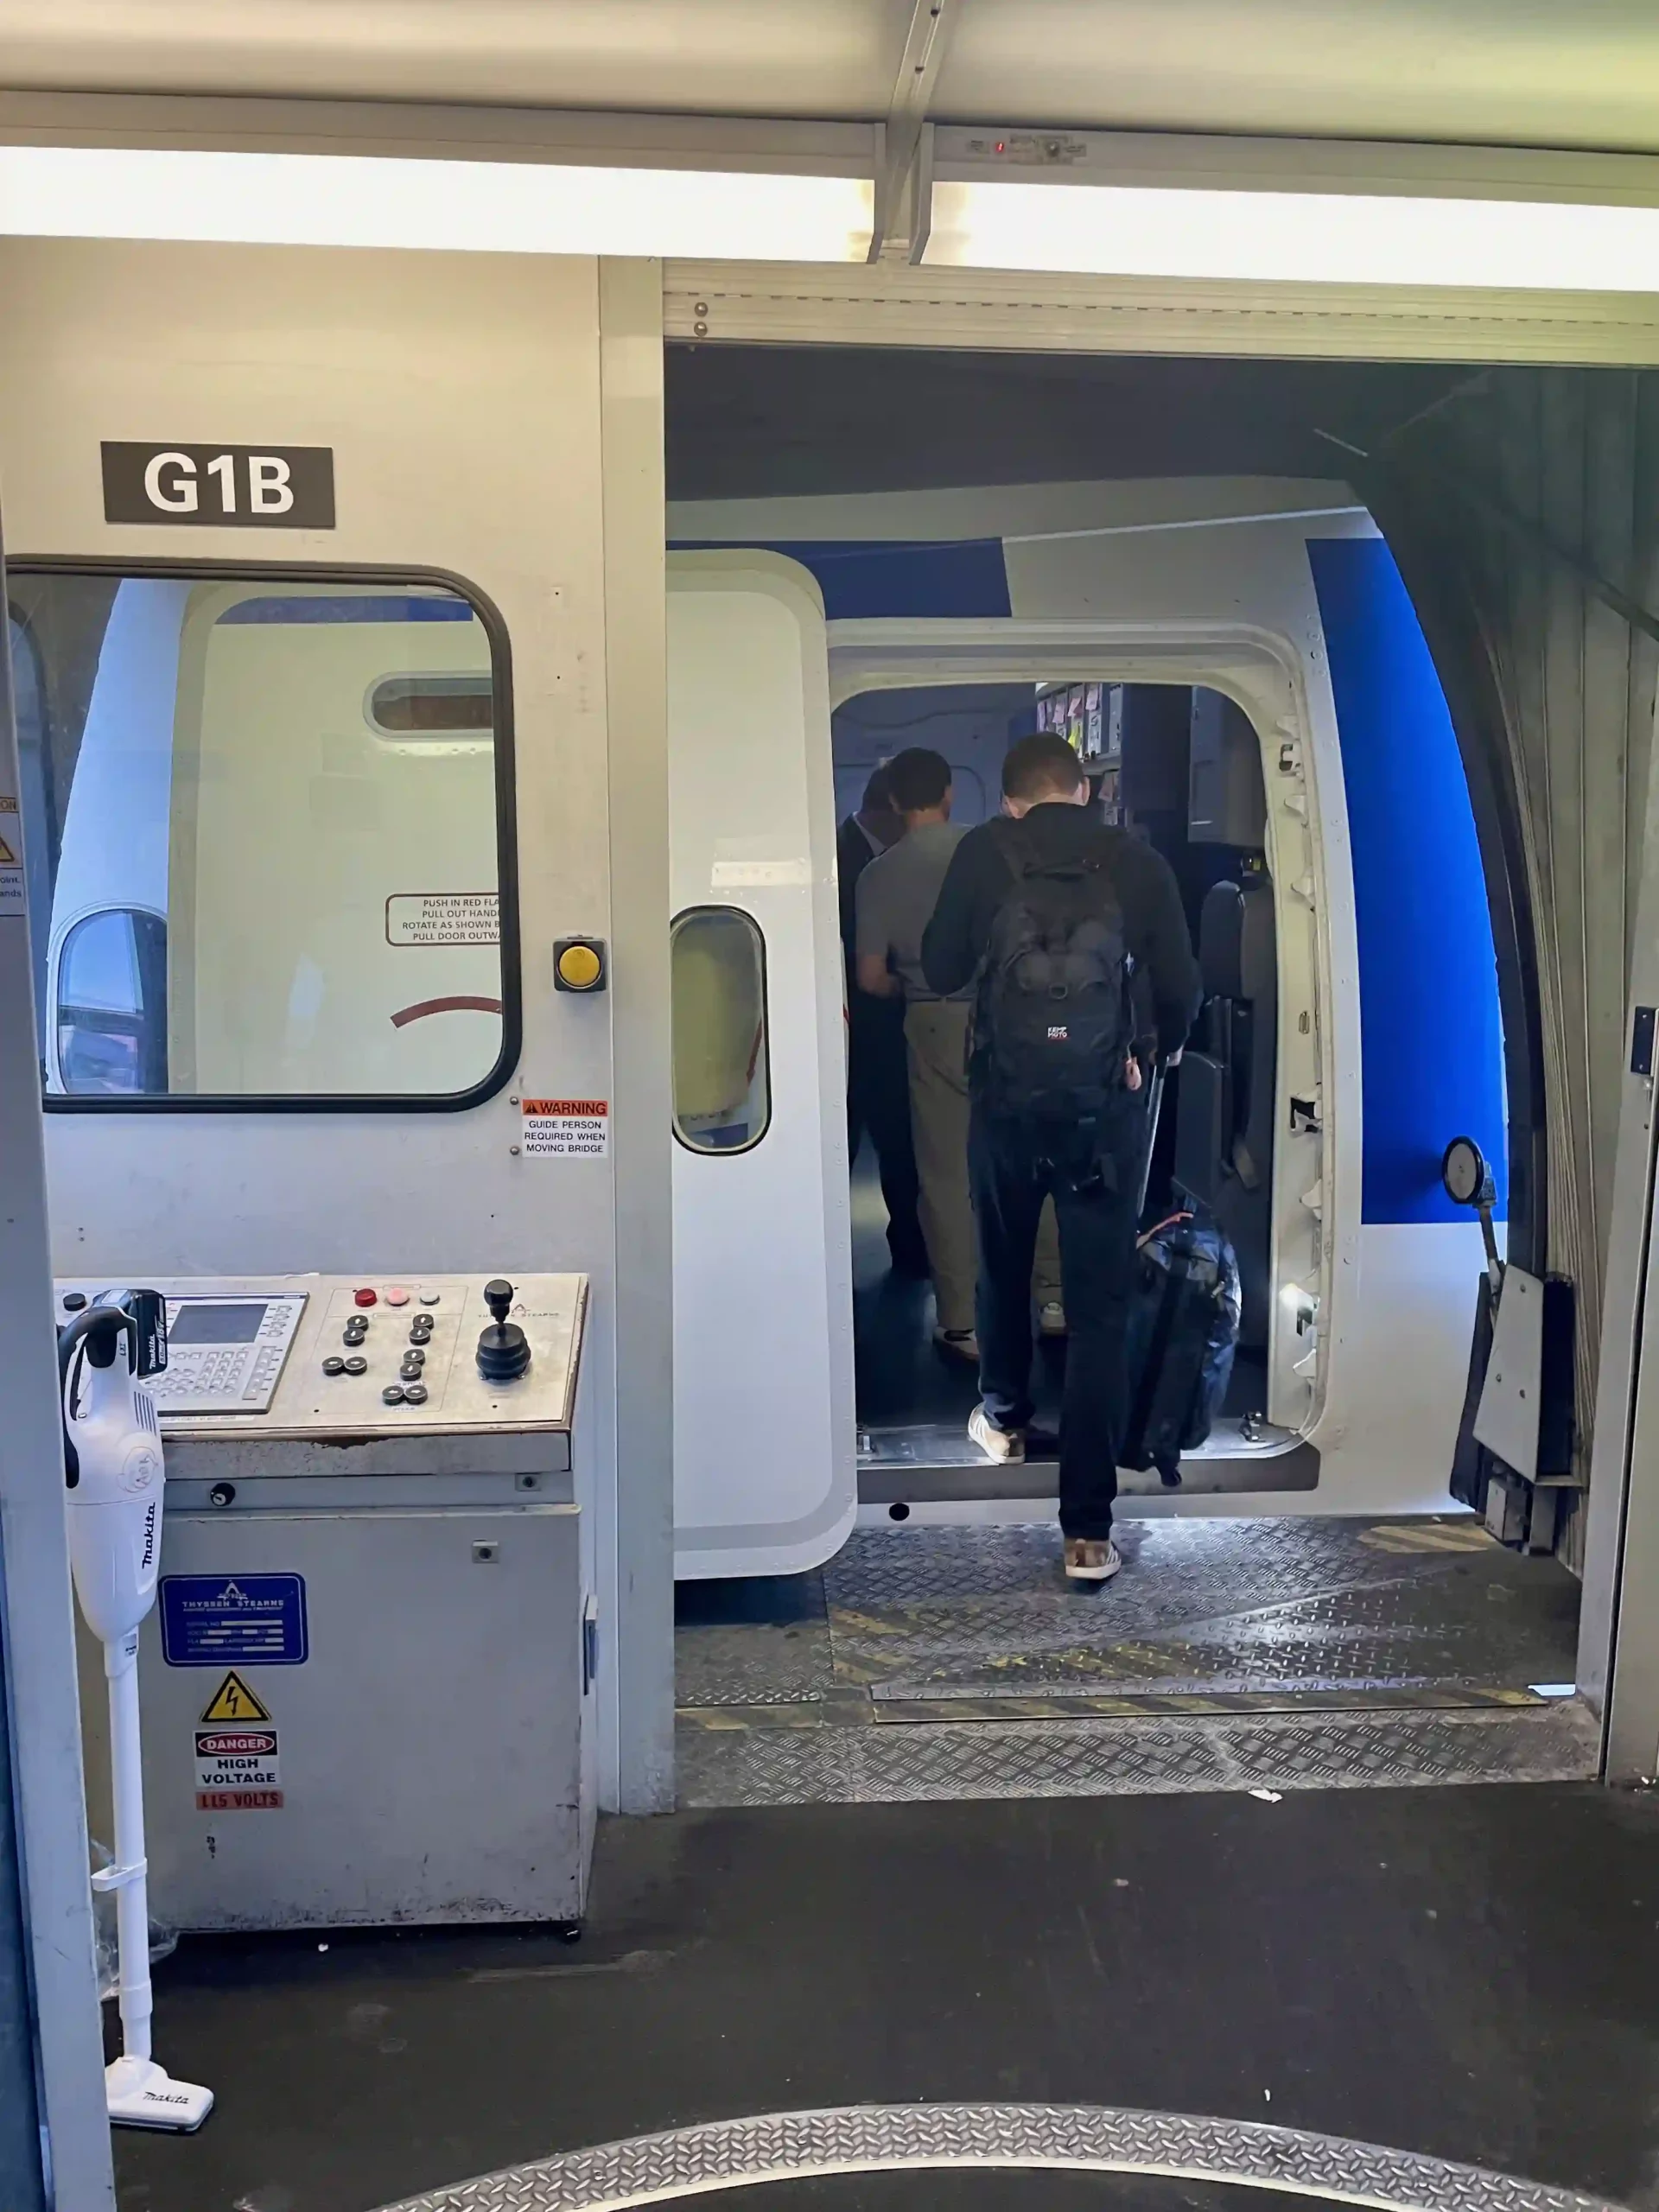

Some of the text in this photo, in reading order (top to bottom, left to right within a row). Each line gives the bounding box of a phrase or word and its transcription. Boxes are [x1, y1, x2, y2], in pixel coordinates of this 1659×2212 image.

[144, 452, 295, 514] G1B
[423, 899, 448, 907] PUSH
[422, 910, 444, 918] PULL
[403, 921, 437, 930] ROTATE
[413, 932, 435, 941] PULL
[540, 1102, 606, 1115] WARNING
[529, 1120, 601, 1129] GUIDE PERSON
[524, 1132, 574, 1141] REQUIRED
[526, 1144, 603, 1153] MOVING BRIDGE
[207, 1738, 267, 1750] DANGER
[217, 1758, 258, 1770] HIGH
[201, 1772, 276, 1784] VOLTAGE
[201, 1792, 278, 1808] 115 VOLTS
